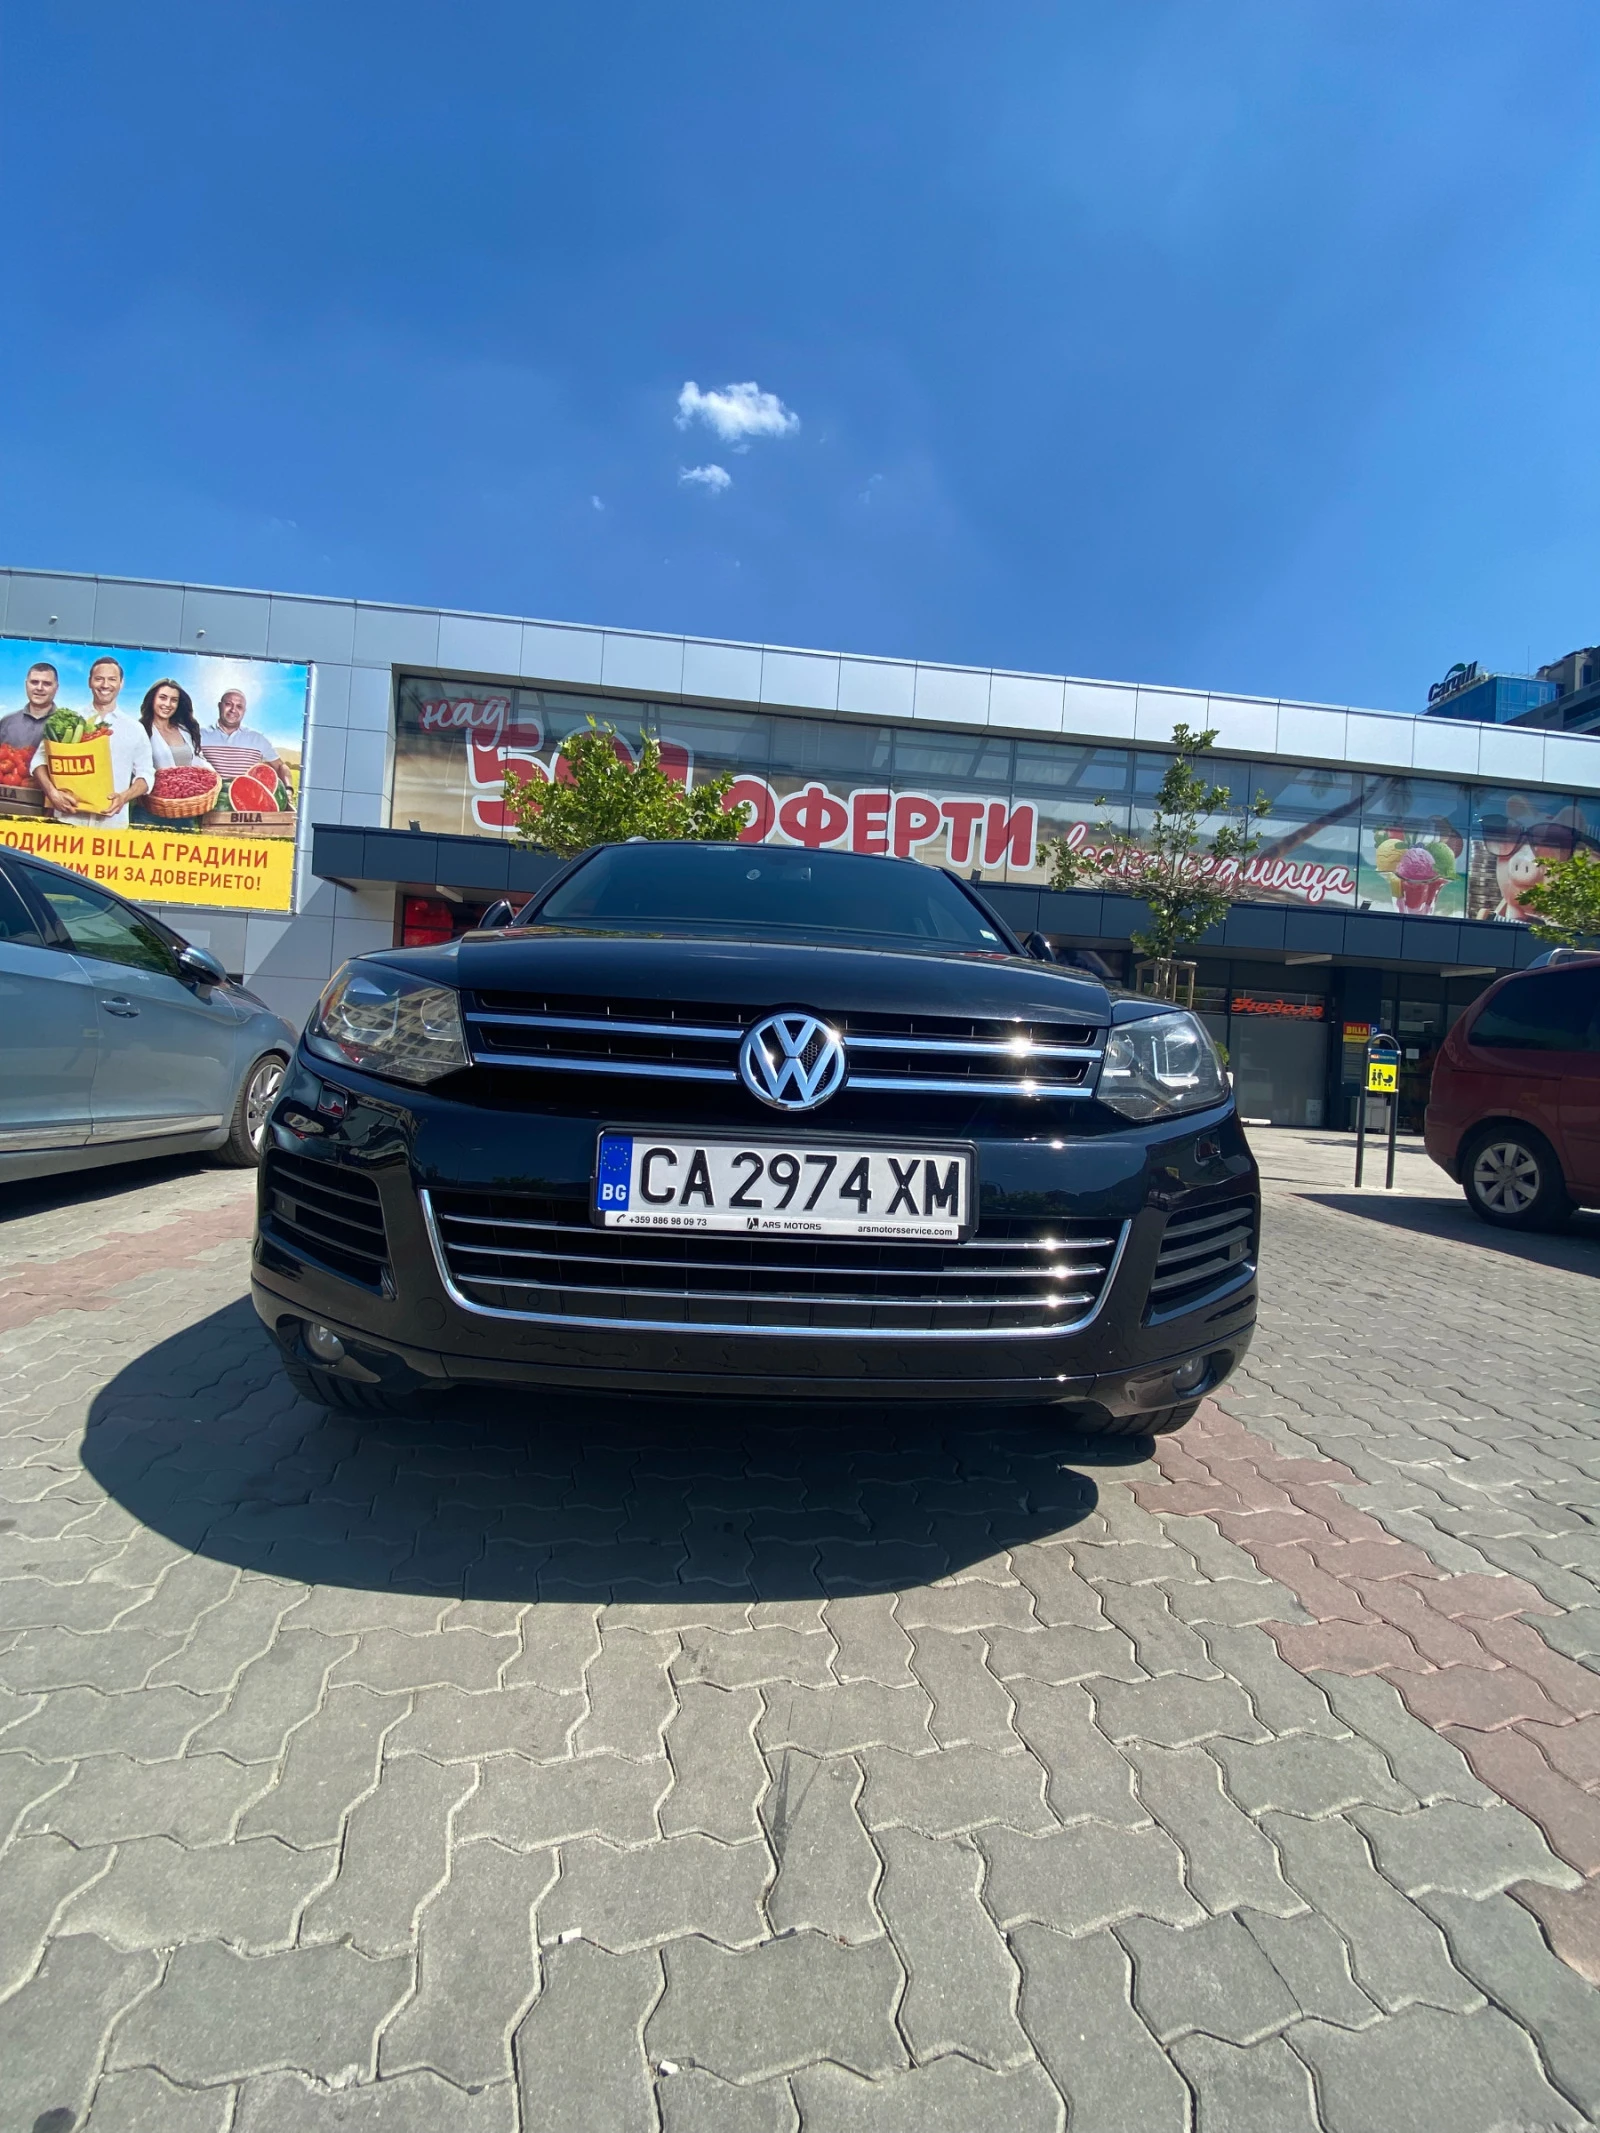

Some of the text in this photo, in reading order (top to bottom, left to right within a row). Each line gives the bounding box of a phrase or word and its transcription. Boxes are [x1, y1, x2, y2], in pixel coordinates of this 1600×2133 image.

[1428, 660, 1478, 702] Cargill
[419, 697, 509, 752] над
[50, 758, 93, 773] BILLA
[230, 812, 262, 823] BILLA
[721, 775, 1038, 872] ОФЕРТИ
[0, 831, 269, 869] ОДИНИ BILLA ГРАДИНИ
[95, 864, 119, 880] ВИ
[124, 867, 146, 882] ЗА
[150, 869, 262, 891] ДОВЕРИЕТО!
[1346, 1026, 1378, 1036] BILLA P
[640, 1146, 959, 1217] CA 2974 XM
[602, 1183, 627, 1201] BG
[629, 1215, 708, 1227] +359 886 98 09 73
[762, 1221, 822, 1231] ARS MOTORS
[857, 1225, 953, 1237] arsmotorsservice.com
